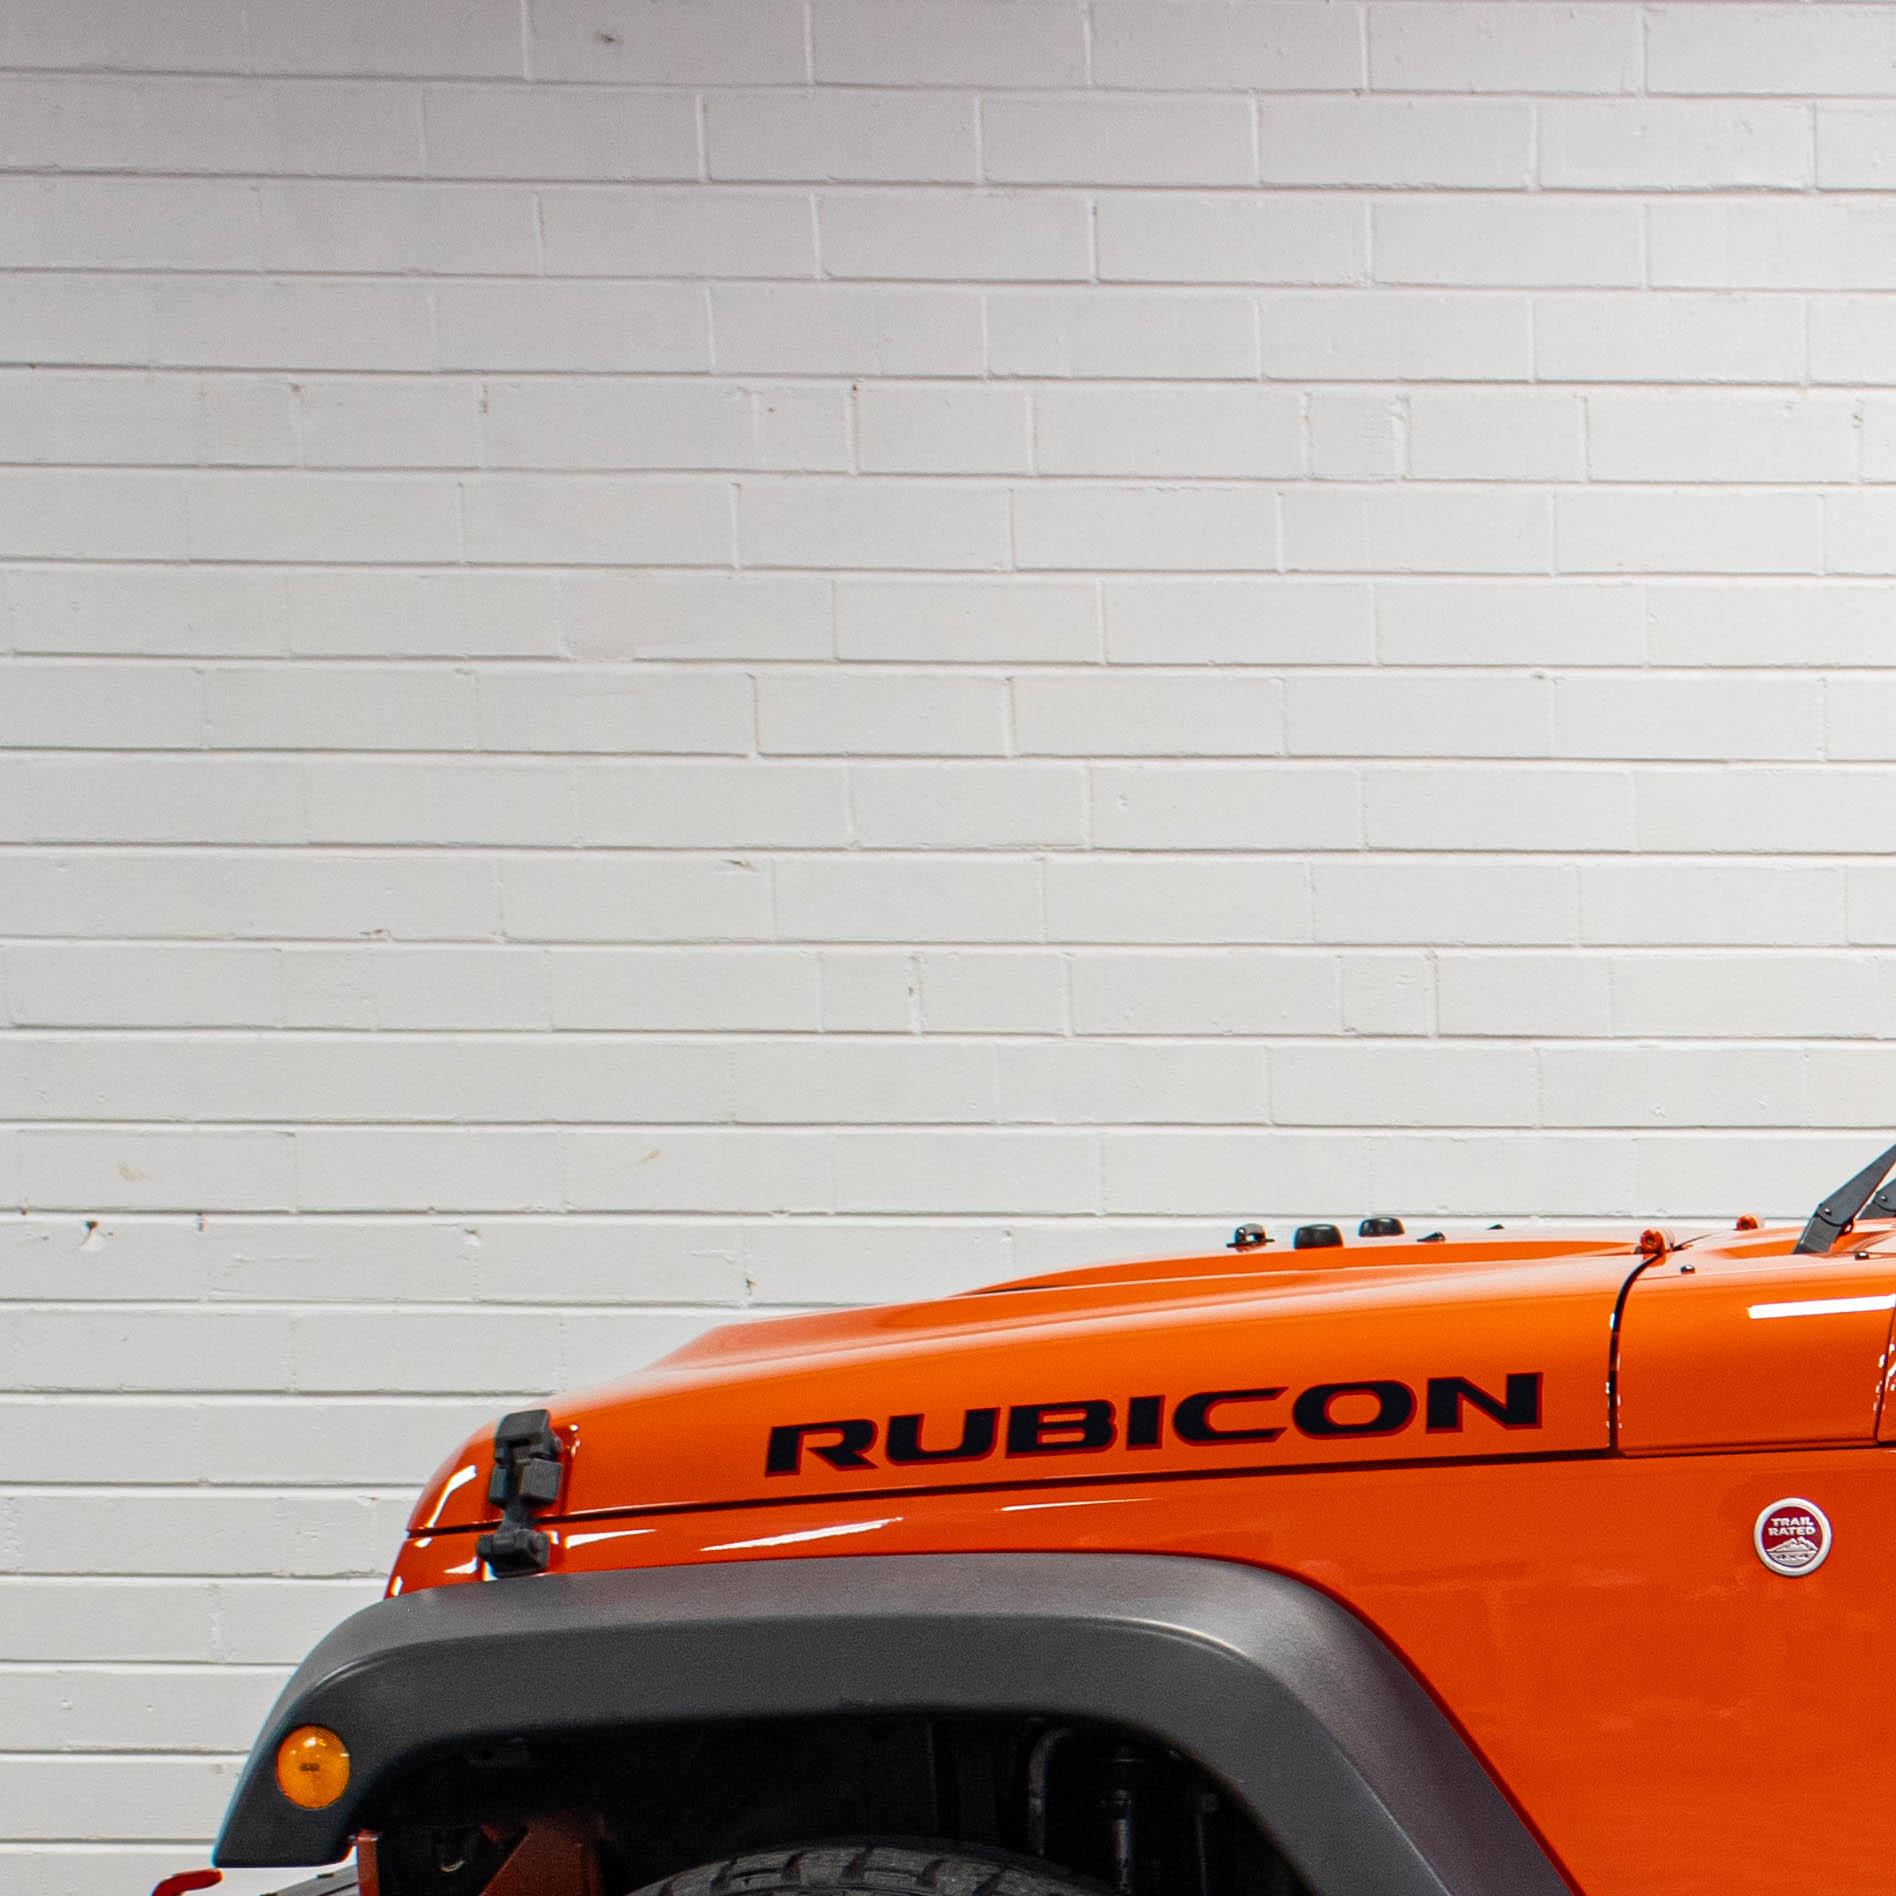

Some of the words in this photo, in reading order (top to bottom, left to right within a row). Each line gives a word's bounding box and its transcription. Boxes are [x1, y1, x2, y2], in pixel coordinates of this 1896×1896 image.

[764, 1371, 1543, 1476] RUBICON
[1770, 1516, 1814, 1527] TRAIL
[1767, 1526, 1816, 1536] RATED
